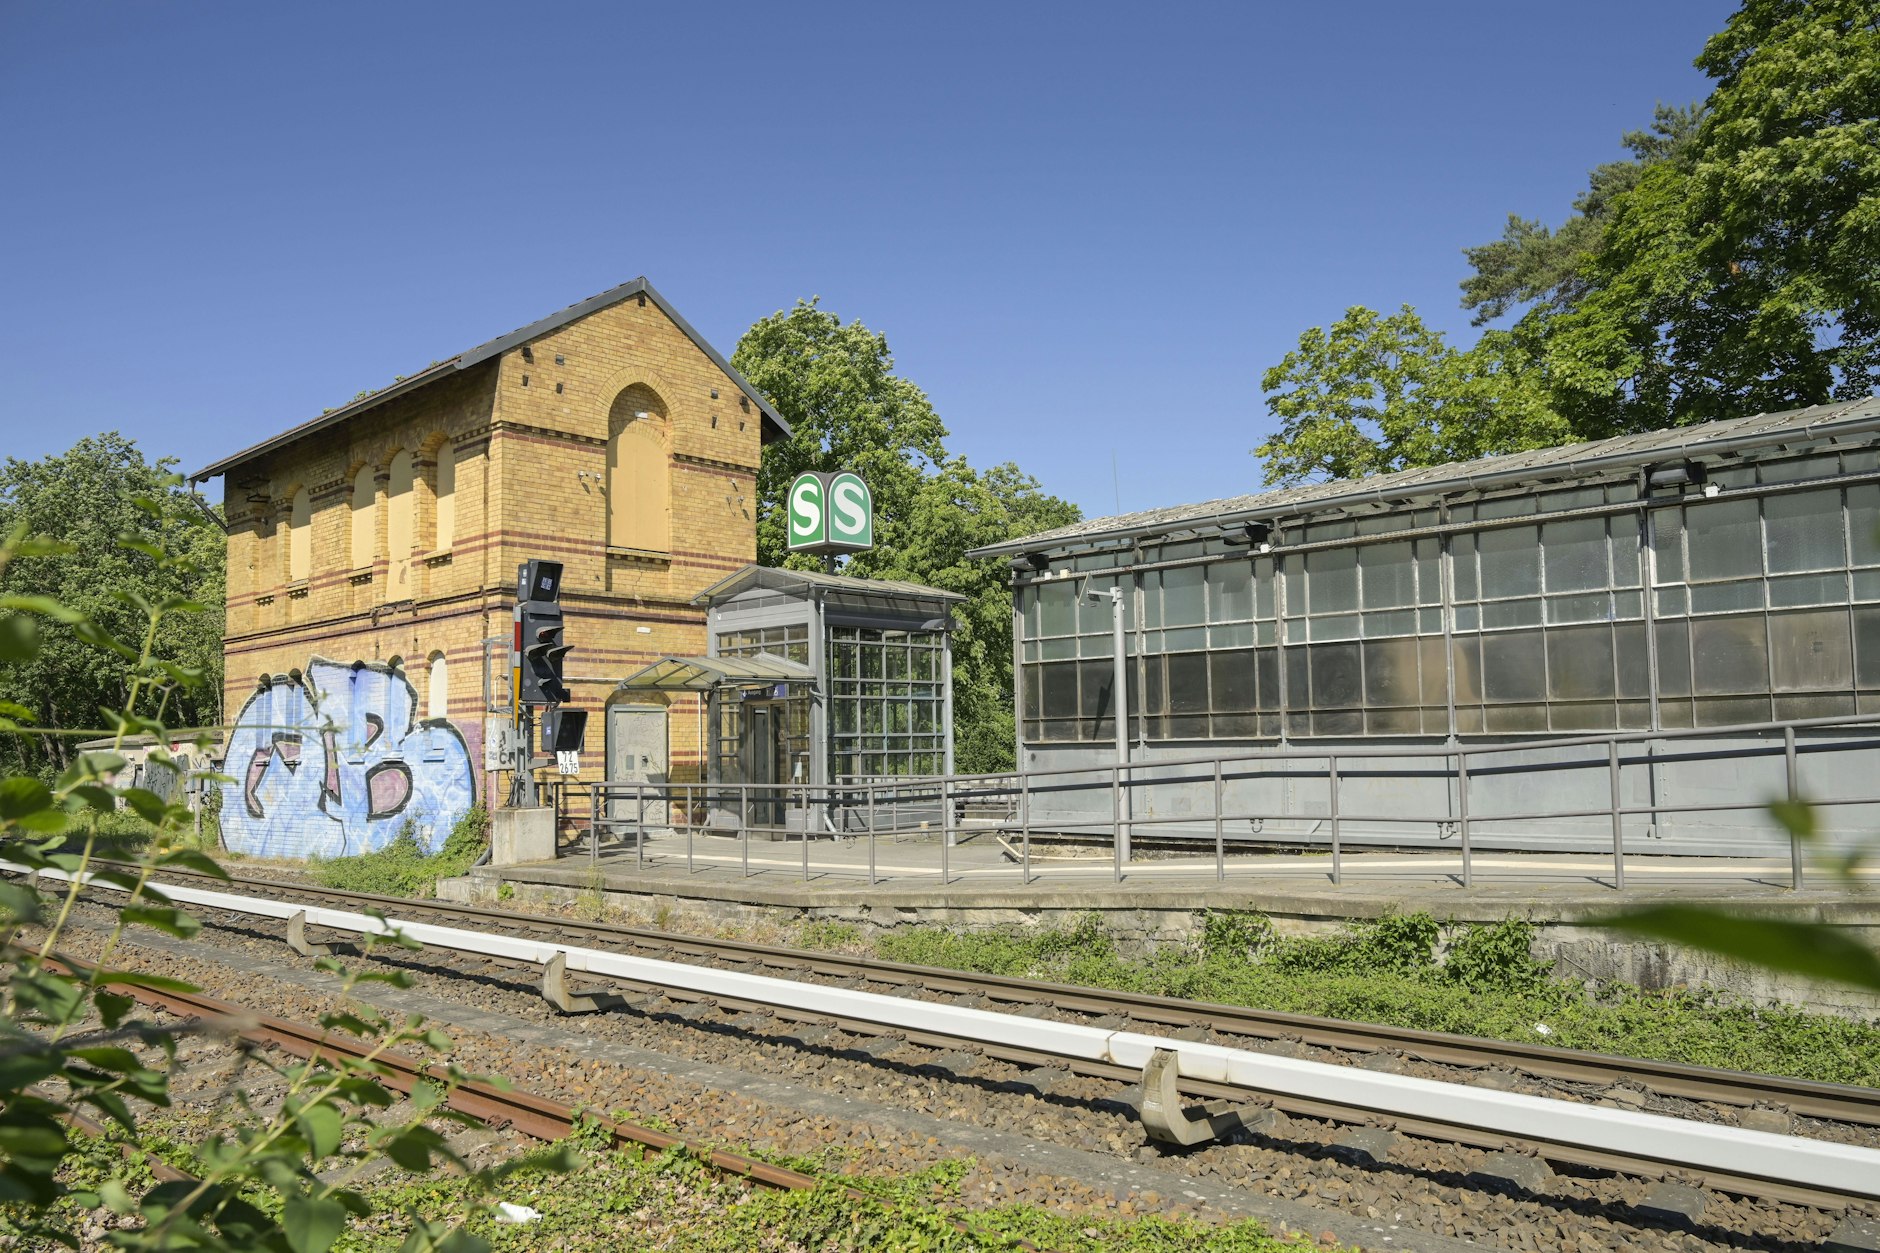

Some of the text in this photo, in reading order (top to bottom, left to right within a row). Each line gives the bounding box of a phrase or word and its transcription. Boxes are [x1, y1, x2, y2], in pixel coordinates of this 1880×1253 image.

[793, 483, 820, 536] S
[834, 482, 866, 535] S
[560, 763, 578, 773] 2675
